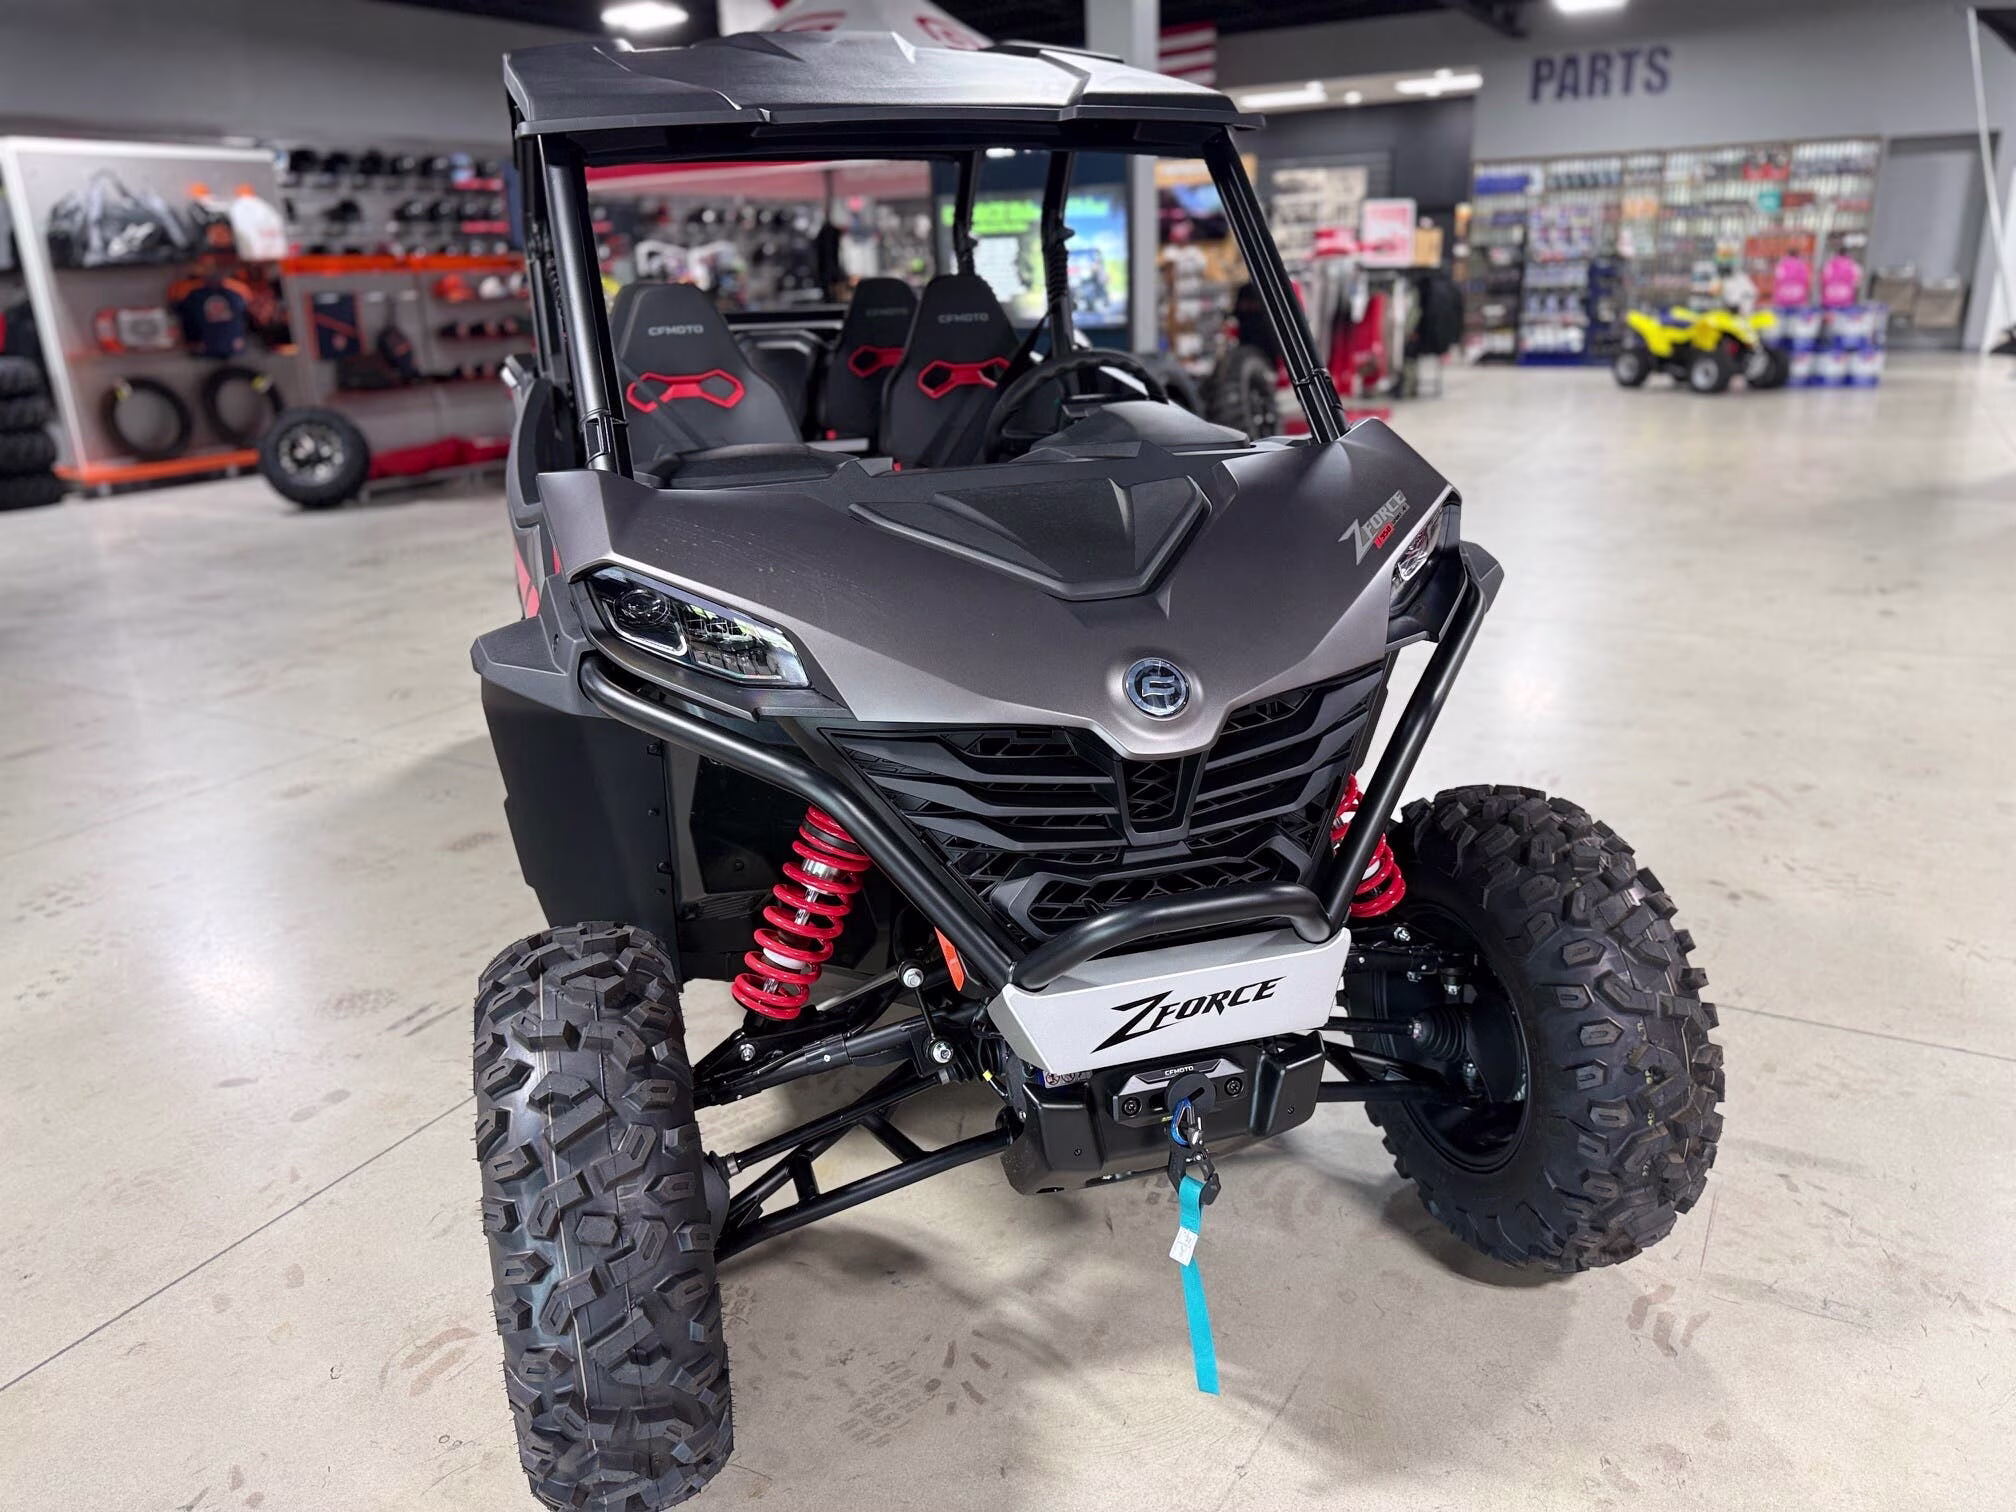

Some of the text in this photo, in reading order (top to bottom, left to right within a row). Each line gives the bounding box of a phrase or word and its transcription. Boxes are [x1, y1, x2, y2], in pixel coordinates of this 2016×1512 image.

[1529, 45, 1672, 103] PARTS
[648, 324, 704, 337] CFMOTO
[1090, 976, 1287, 1055] ZFORCE
[1164, 1065, 1194, 1076] CFMOTO
